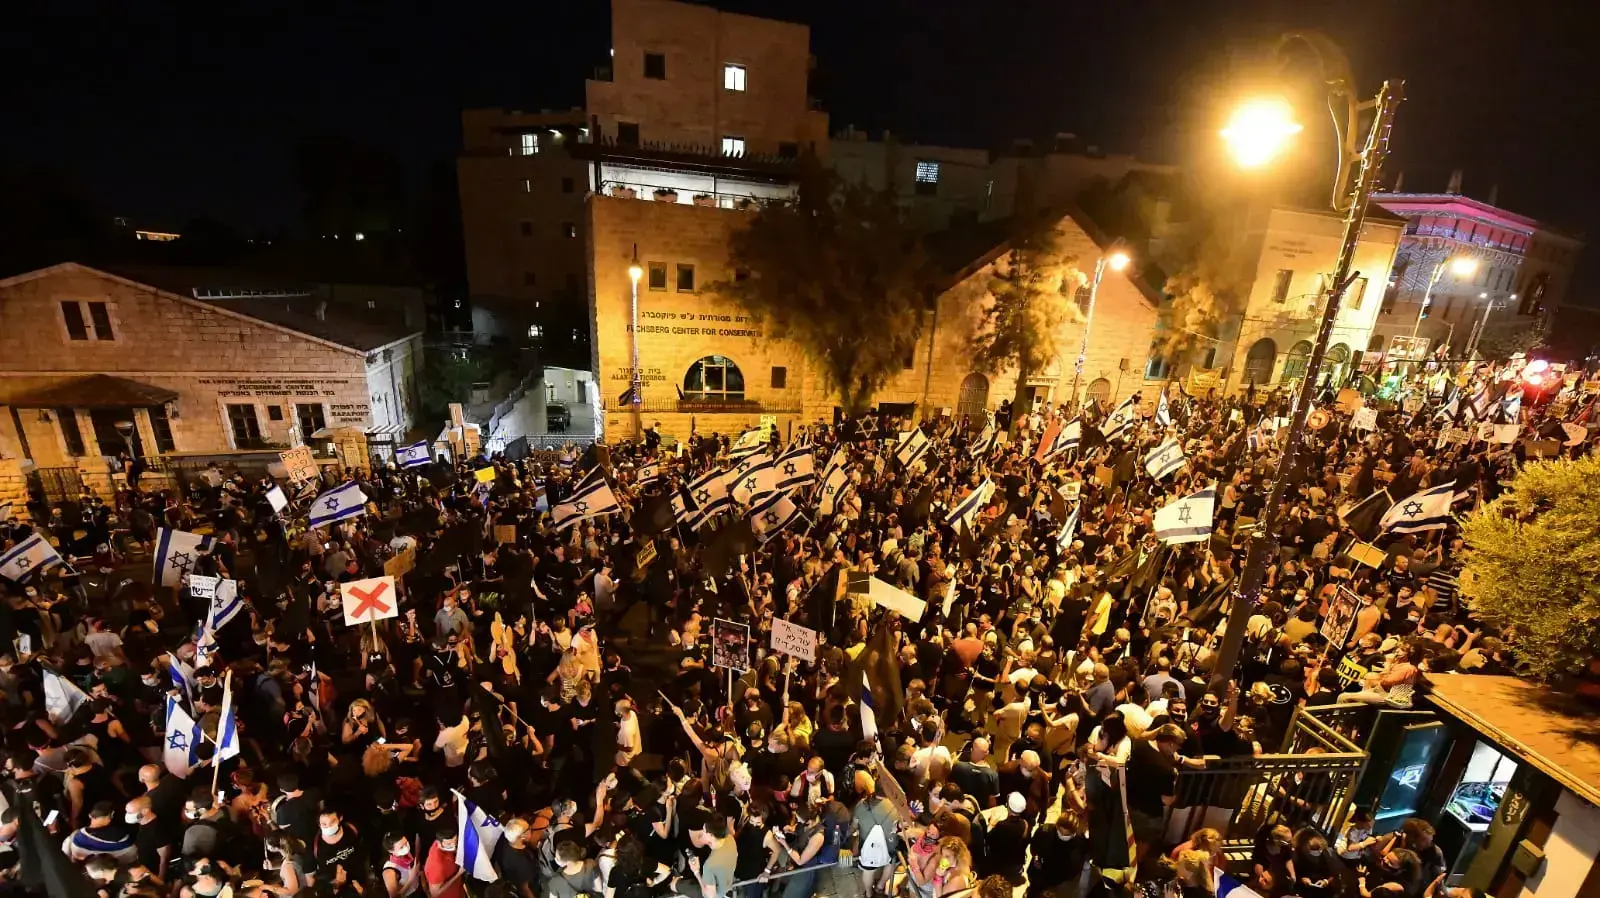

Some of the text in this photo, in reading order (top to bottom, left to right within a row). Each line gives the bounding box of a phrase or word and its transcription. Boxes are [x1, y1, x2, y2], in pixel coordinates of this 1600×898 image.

[641, 311, 677, 320] פיוקסברג
[672, 326, 699, 335] CENTER
[701, 328, 716, 336] FOR
